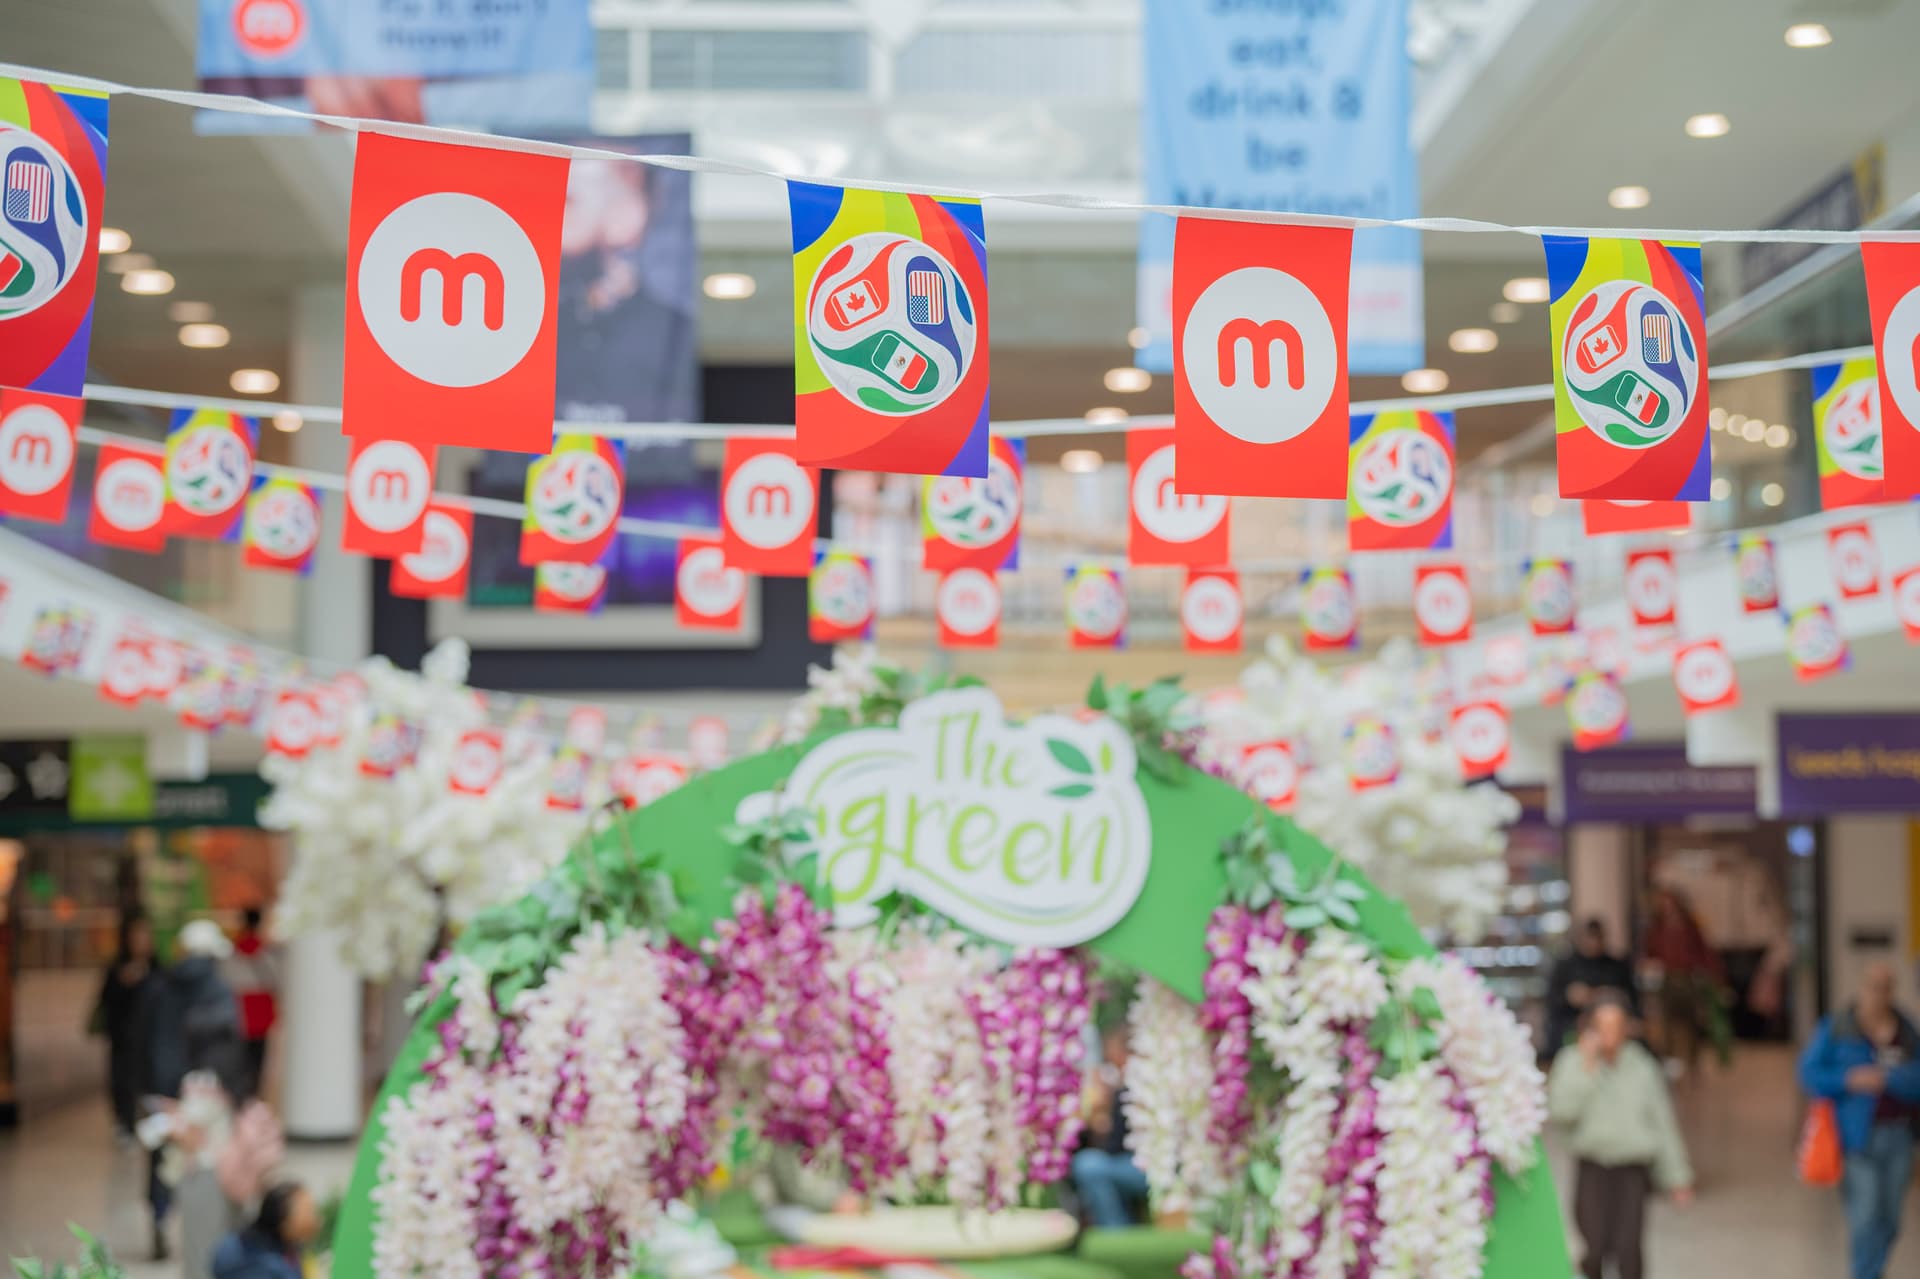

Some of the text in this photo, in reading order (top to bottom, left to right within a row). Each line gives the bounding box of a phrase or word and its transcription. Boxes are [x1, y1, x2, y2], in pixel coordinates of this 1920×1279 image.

[401, 247, 505, 331] m
[1217, 317, 1305, 390] m
[11, 432, 54, 465] m
[367, 468, 410, 503] m
[746, 483, 792, 515] m
[923, 710, 1038, 788] The
[823, 792, 1112, 904] green
